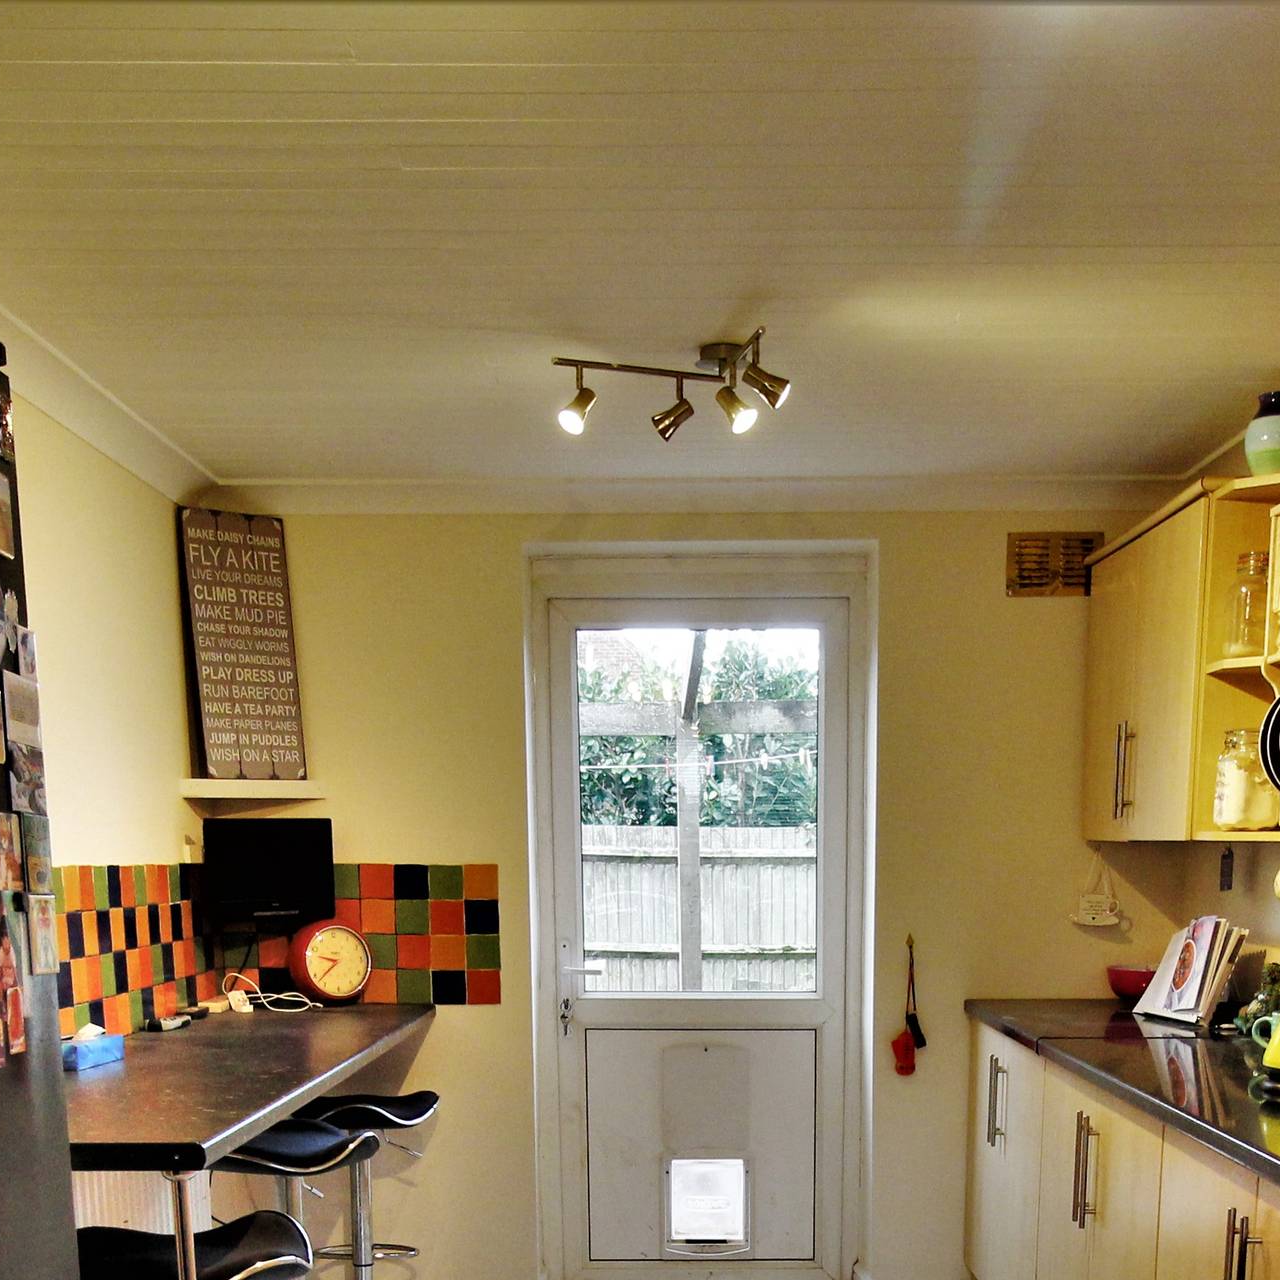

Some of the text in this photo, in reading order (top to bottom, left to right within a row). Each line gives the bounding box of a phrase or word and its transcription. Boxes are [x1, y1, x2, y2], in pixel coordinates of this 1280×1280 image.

[188, 528, 280, 548] MAKE DAISY CHAINS
[189, 544, 281, 573] FLY A KITE
[192, 569, 282, 588] LIVE YOUR DREAMS
[194, 584, 284, 607] CLIMB TREES
[195, 604, 286, 625] MAKE MUD PIE
[197, 622, 288, 638] CHASE YOUR SHADOW
[198, 636, 289, 652] EAT WIGGLY WORMS
[200, 652, 291, 667] WISH ON DANDELIONS
[202, 666, 293, 684] PLAY DRESS UP
[204, 684, 294, 701] RUN BAREFOOT
[205, 702, 296, 717] HAVE A TEA PARTY
[206, 718, 298, 732] MAKE PAPER PLANES
[209, 733, 298, 746] JUMP IN PUDDLES
[210, 748, 299, 762] WISH ON A STAR
